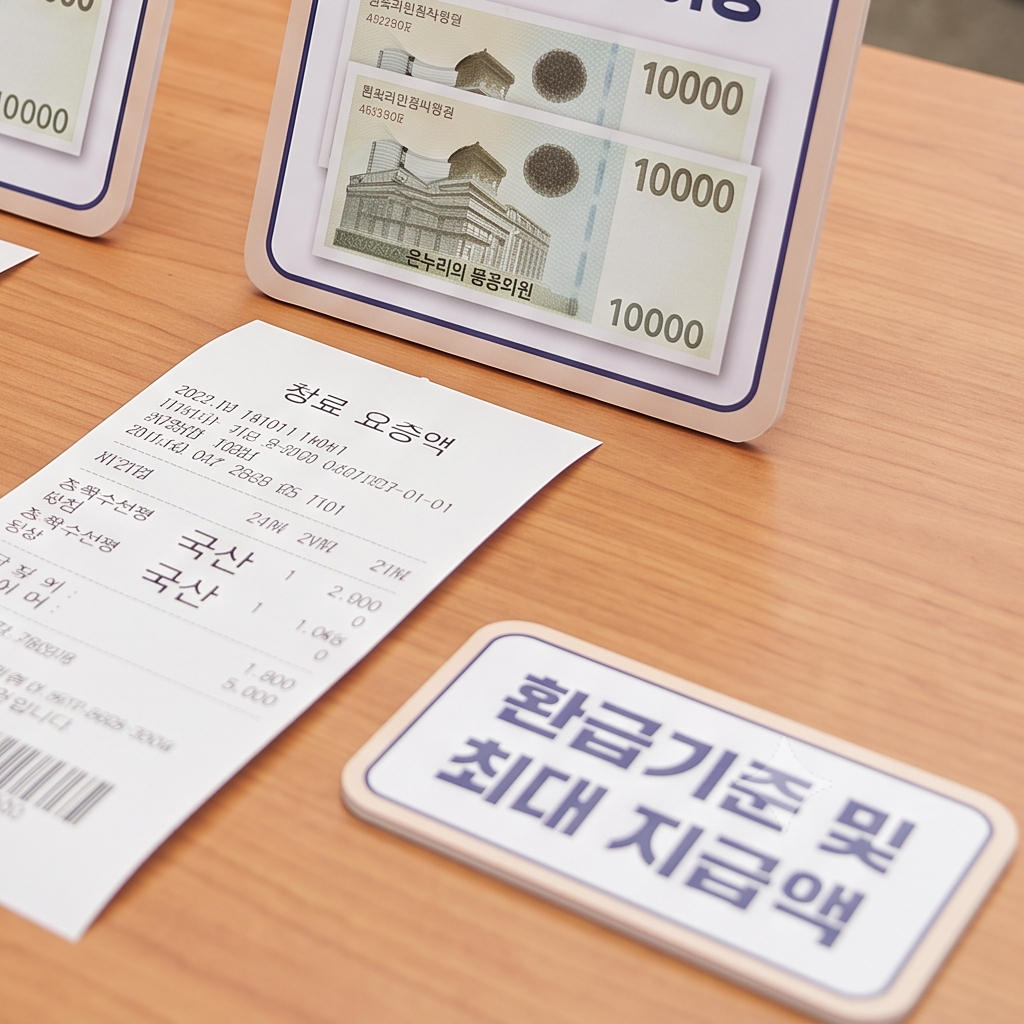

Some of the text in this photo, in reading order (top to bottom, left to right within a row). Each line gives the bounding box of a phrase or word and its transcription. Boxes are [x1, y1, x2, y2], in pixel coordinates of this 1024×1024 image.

[641, 61, 744, 116] 10000
[633, 158, 735, 214] 10000
[609, 297, 704, 350] 10000
[178, 529, 255, 575] 국산
[142, 562, 219, 609] 국산
[350, 615, 366, 628] 0
[313, 648, 329, 661] 0
[435, 733, 866, 950] 최대 지급액
[818, 797, 917, 876] 및
